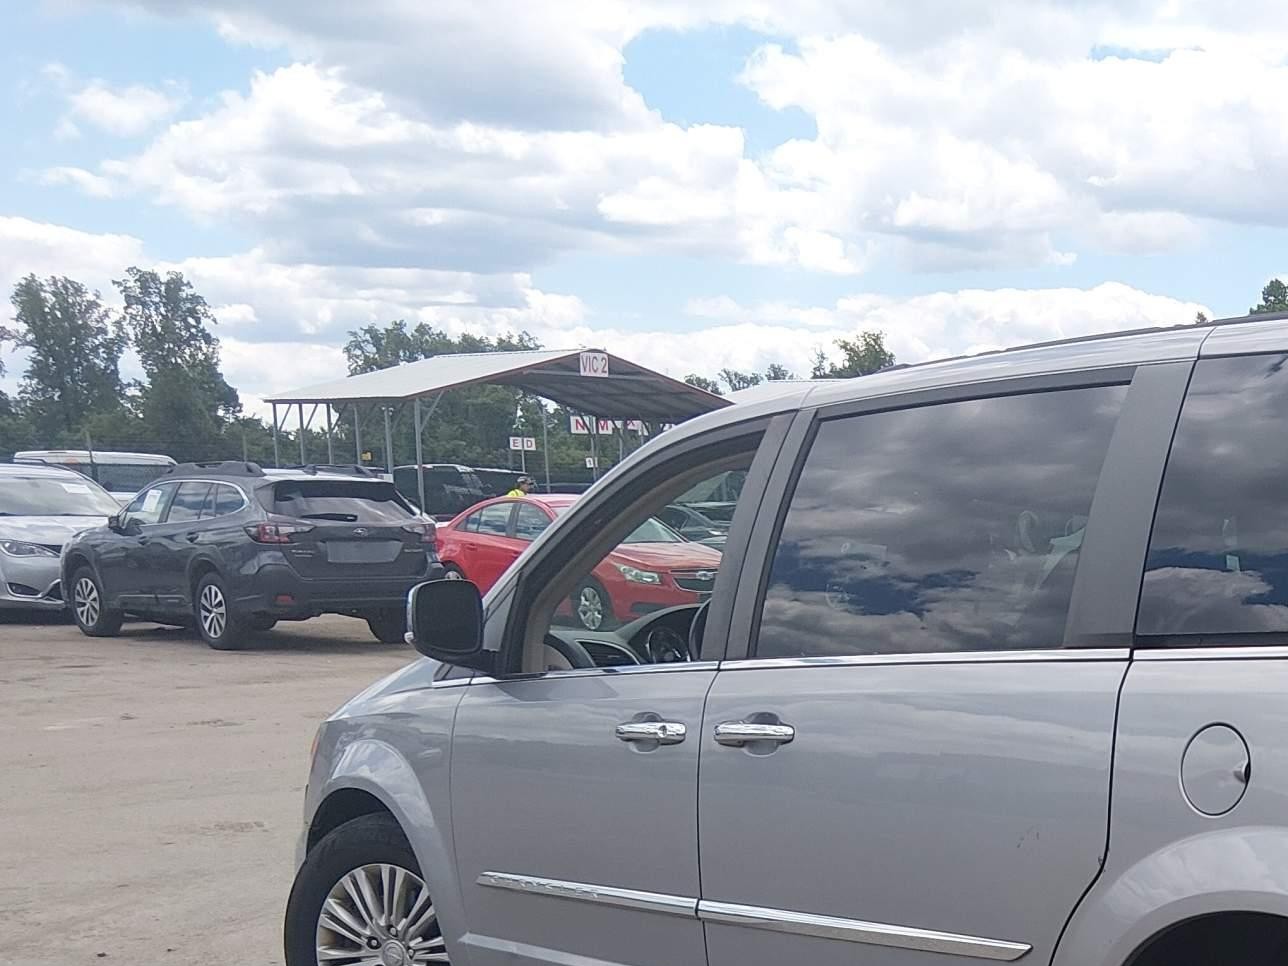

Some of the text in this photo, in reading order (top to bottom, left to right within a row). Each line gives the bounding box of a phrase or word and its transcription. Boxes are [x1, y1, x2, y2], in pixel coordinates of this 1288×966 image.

[581, 355, 608, 374] VIC 2
[512, 438, 519, 448] E
[526, 439, 533, 449] D
